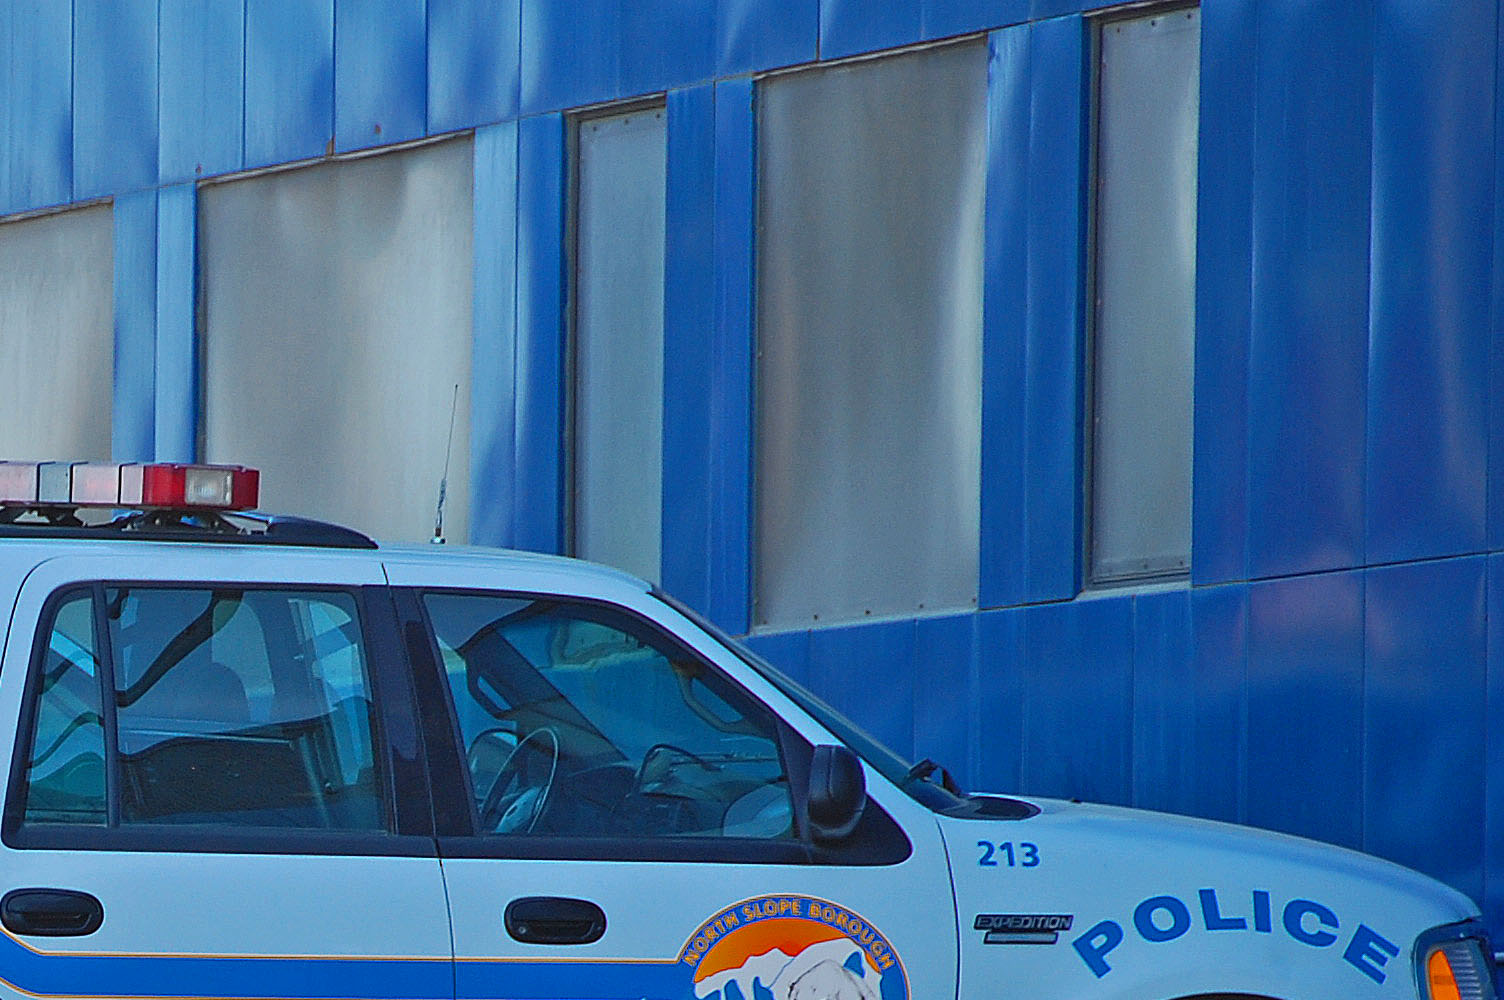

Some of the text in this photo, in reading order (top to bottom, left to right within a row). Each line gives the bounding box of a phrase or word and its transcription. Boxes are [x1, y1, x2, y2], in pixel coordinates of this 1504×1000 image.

[977, 841, 1040, 867] 213
[685, 900, 895, 970] NORTH SLOPE BOROUGH
[976, 915, 1071, 929] EXPEDITION
[1072, 888, 1400, 985] POLICE
